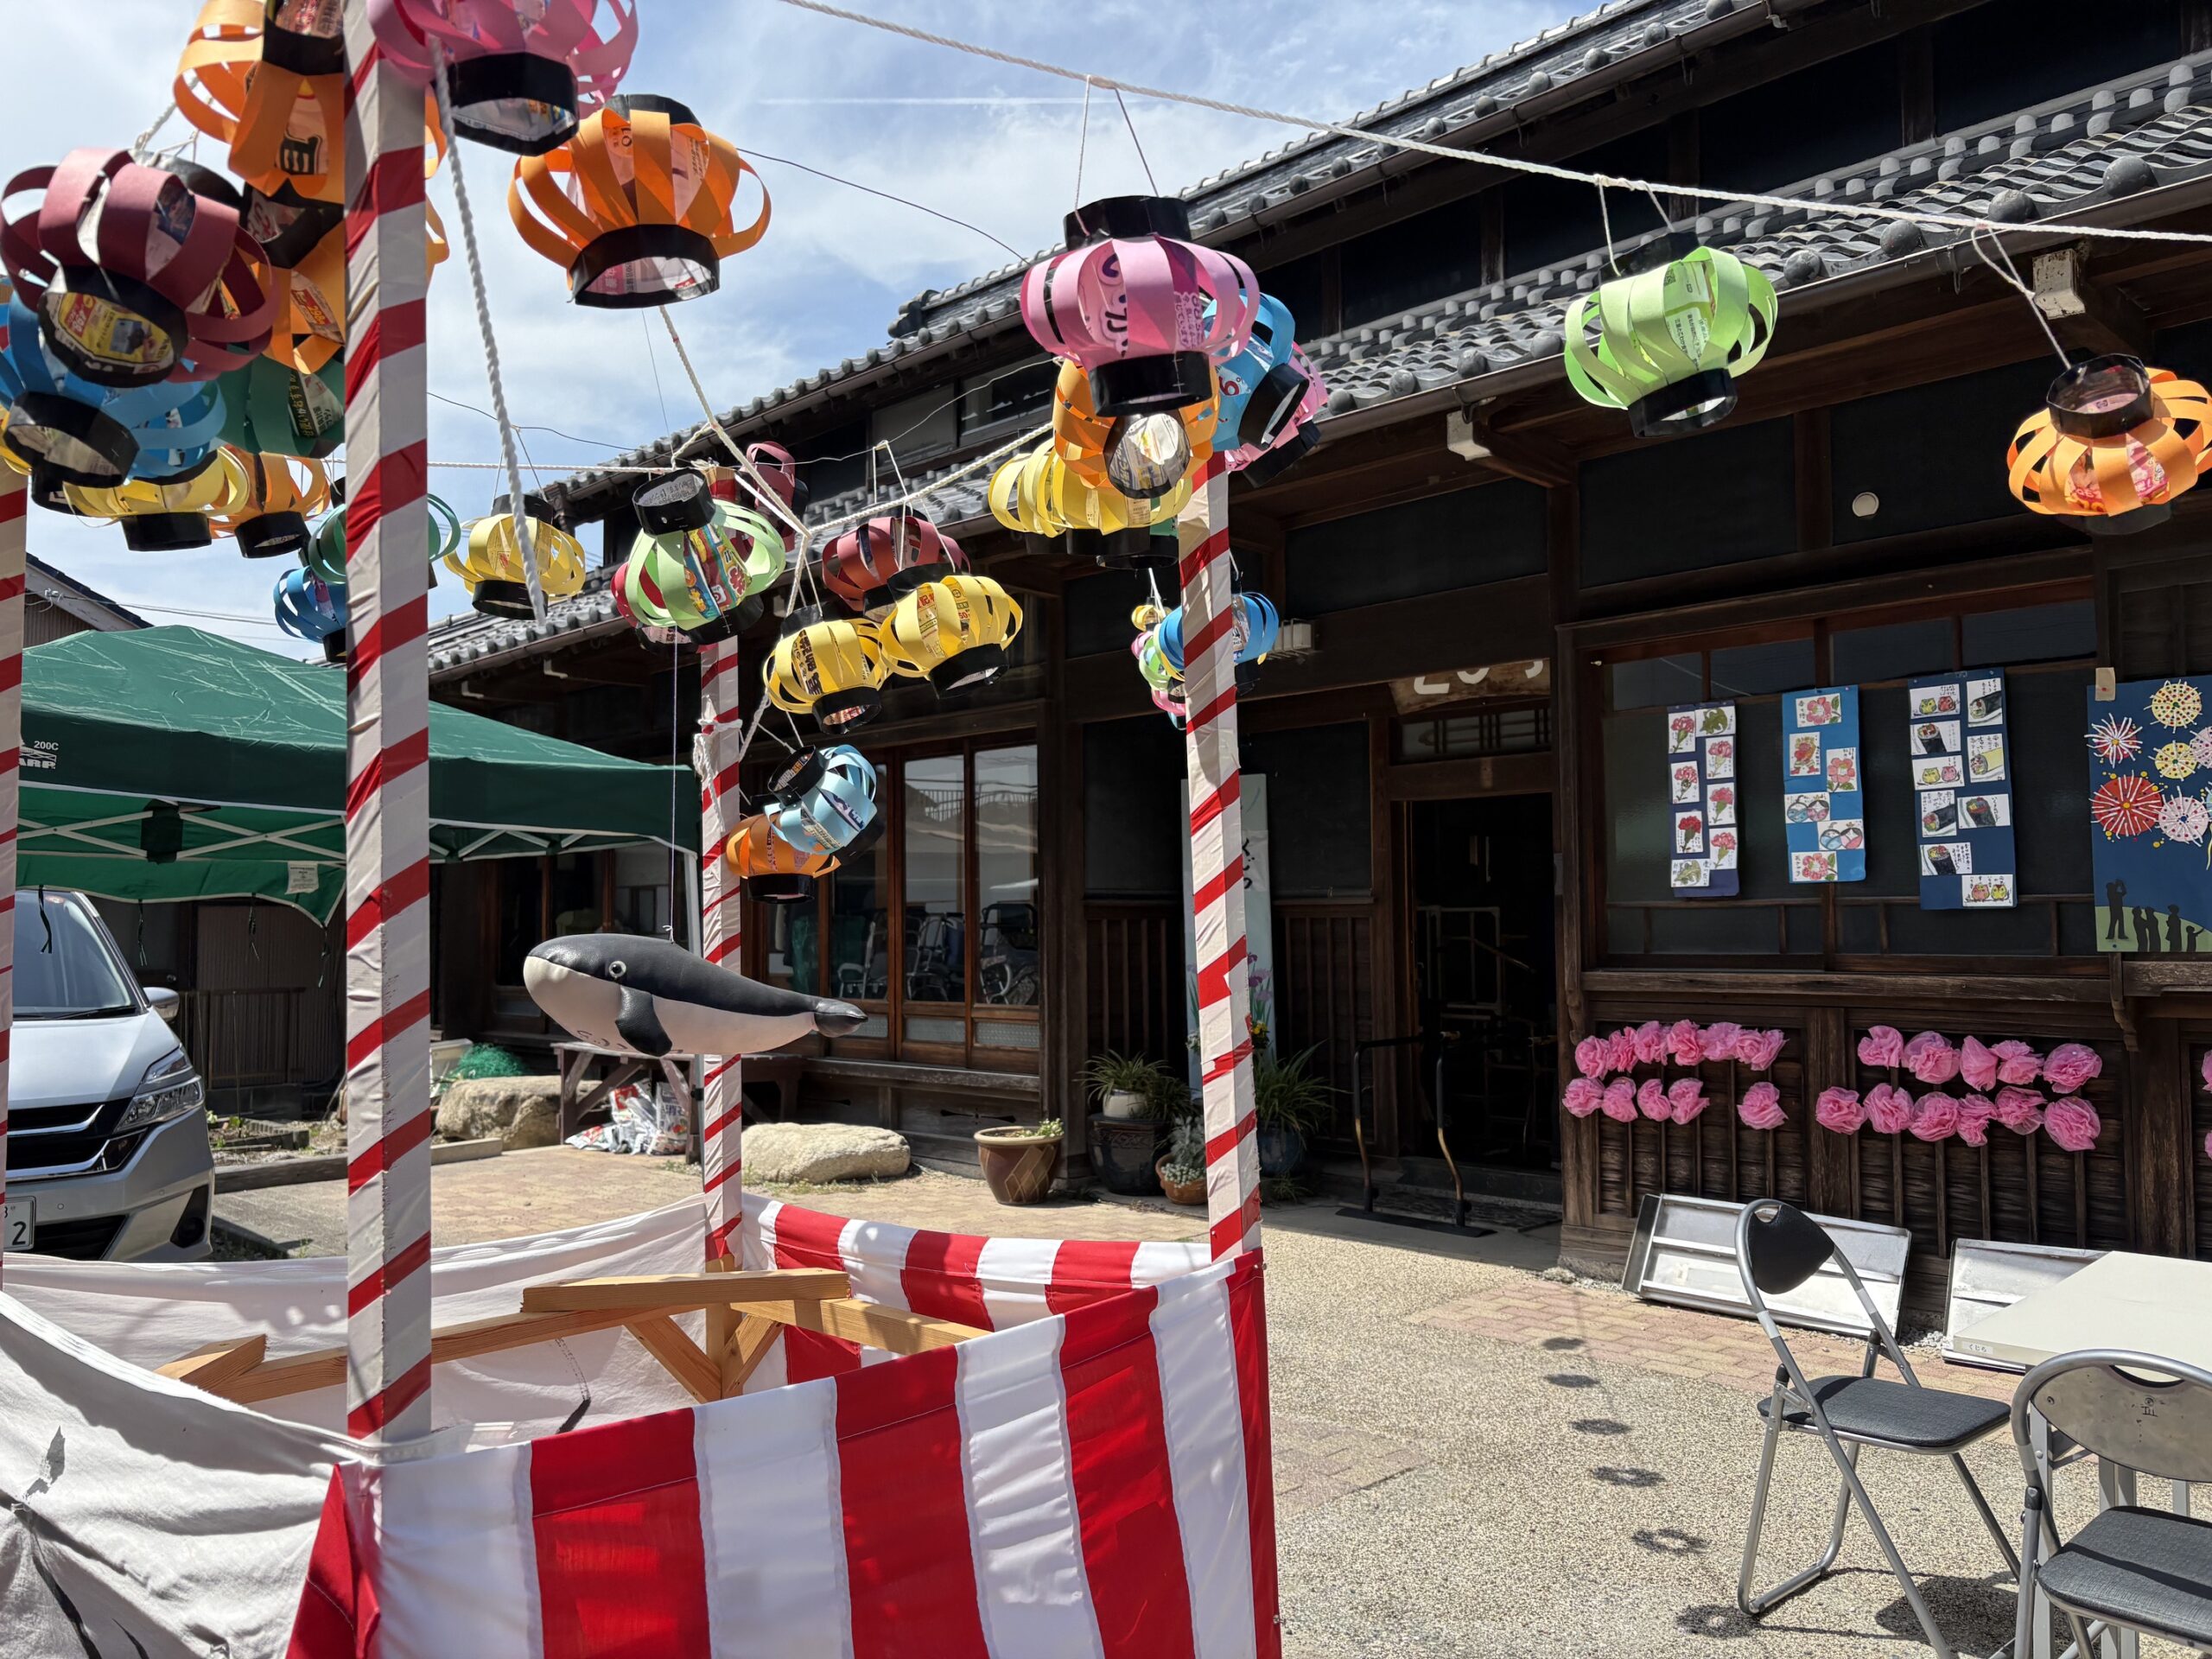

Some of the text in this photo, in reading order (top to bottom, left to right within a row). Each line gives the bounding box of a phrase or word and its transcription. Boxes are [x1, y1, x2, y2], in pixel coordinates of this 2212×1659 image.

[34, 741, 59, 751] 200C
[1969, 1344, 1987, 1353] くじら
